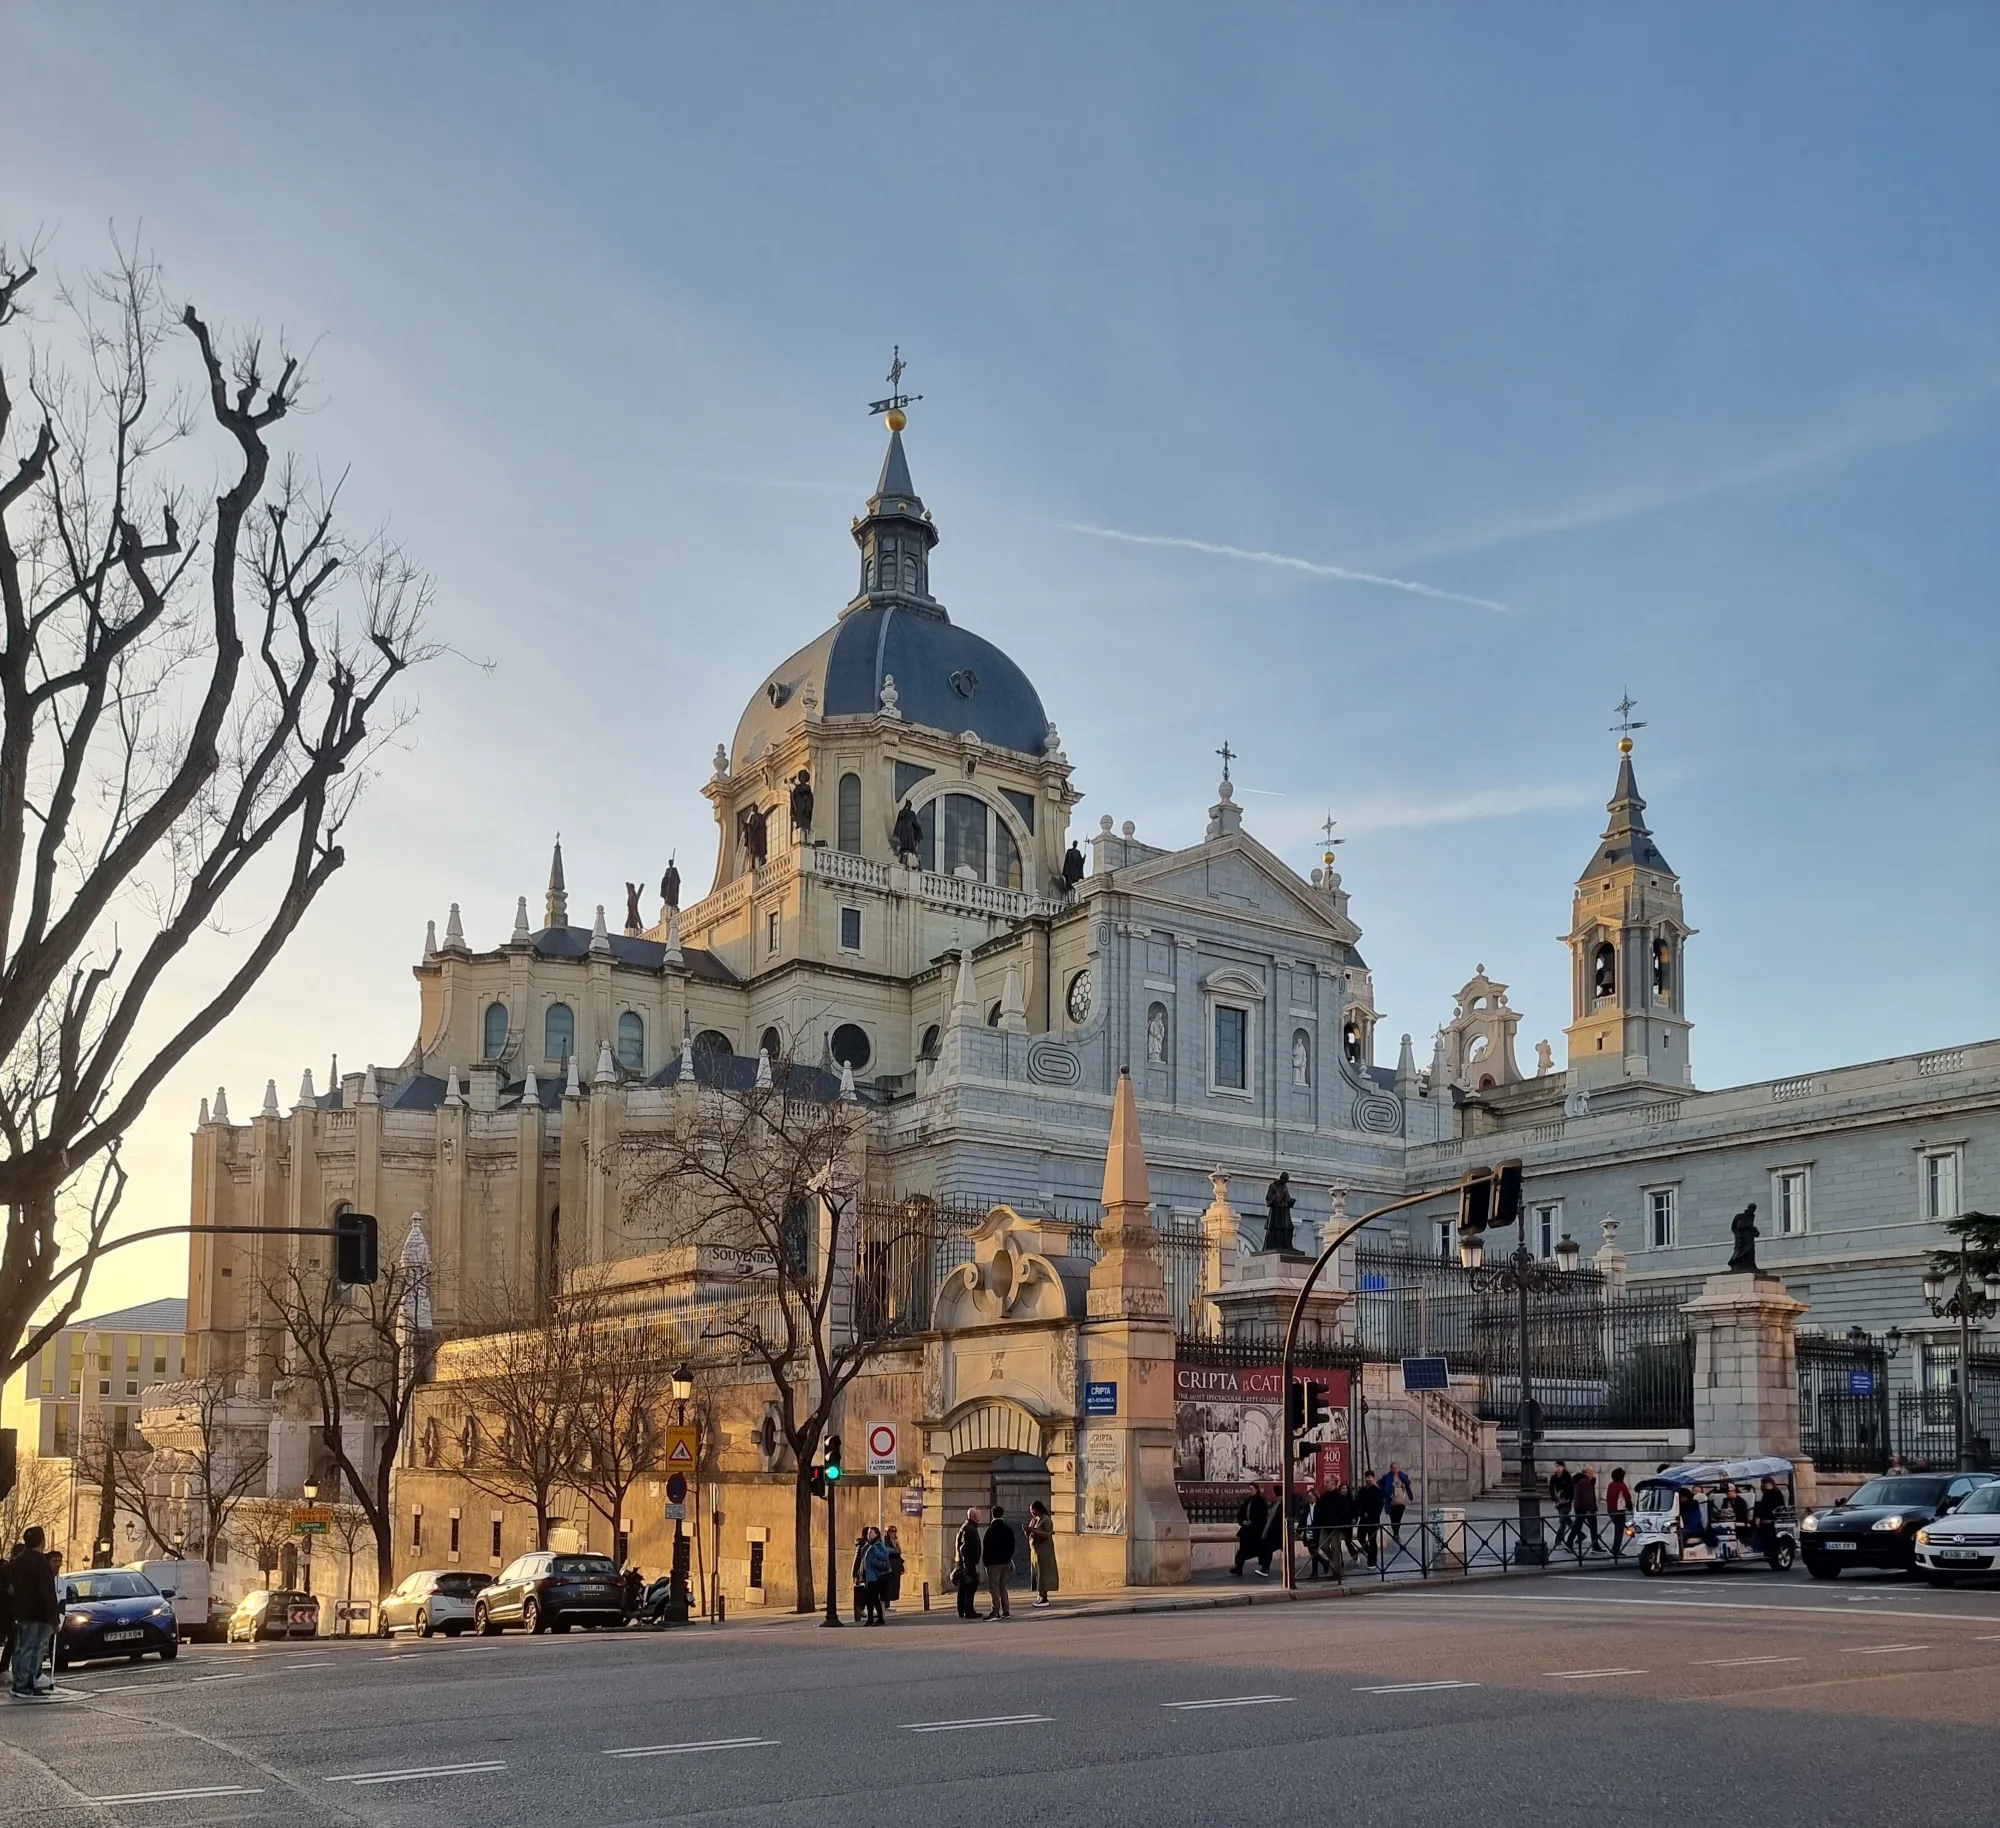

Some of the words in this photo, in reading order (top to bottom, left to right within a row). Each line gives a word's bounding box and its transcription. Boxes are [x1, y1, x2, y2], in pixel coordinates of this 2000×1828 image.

[712, 1247, 774, 1264] SOUVENIRS
[1177, 1371, 1238, 1390] CRIPTA
[1090, 1387, 1111, 1395] CRIPTA
[1206, 1394, 1242, 1402] SPECTACULAR
[1092, 1433, 1113, 1441] CRIPTA
[1323, 1450, 1341, 1462] 400
